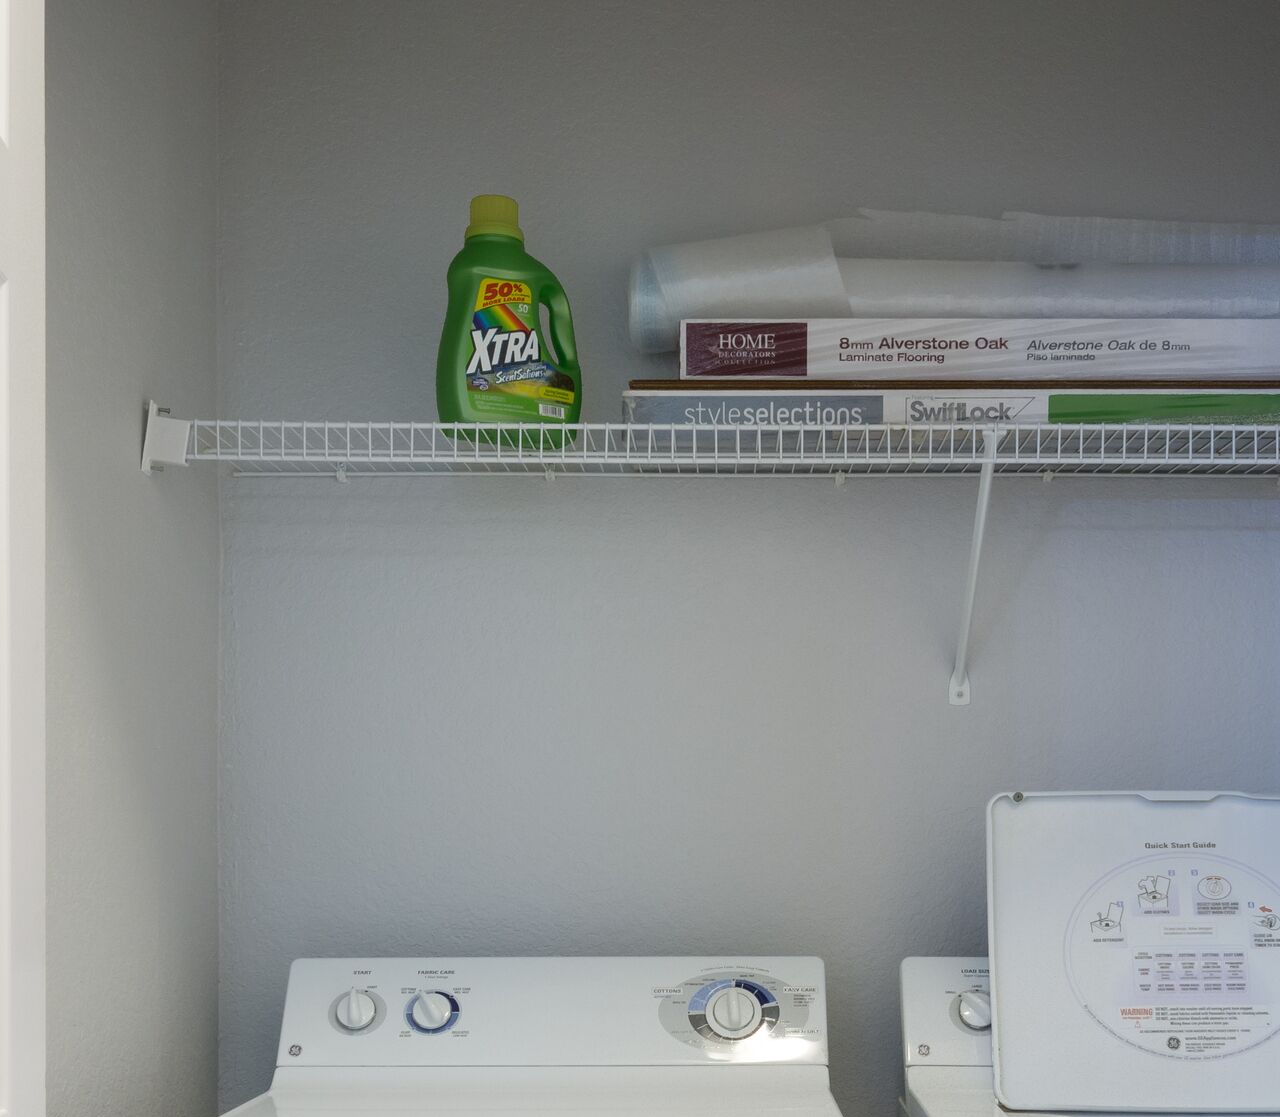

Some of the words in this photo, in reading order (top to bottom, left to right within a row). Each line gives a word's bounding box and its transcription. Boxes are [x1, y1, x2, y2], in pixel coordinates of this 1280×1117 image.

[484, 283, 523, 301] 50%
[719, 334, 776, 349] HOME
[839, 337, 873, 350] 8mm
[878, 337, 969, 350] Alverstone
[975, 337, 1008, 350] Oak
[1026, 340, 1103, 351] Alverstone
[1107, 340, 1136, 351] Oak
[1139, 340, 1157, 351] de
[1162, 341, 1191, 351] 8mm
[466, 328, 539, 374] XTRA
[1026, 353, 1048, 361] Piso
[1050, 353, 1096, 361] laminado
[839, 353, 893, 362] Laminate
[897, 353, 945, 364] Flooring
[684, 401, 863, 425] styleselections
[910, 400, 1012, 422] SwiftLock
[1120, 1008, 1153, 1016] WARNING
